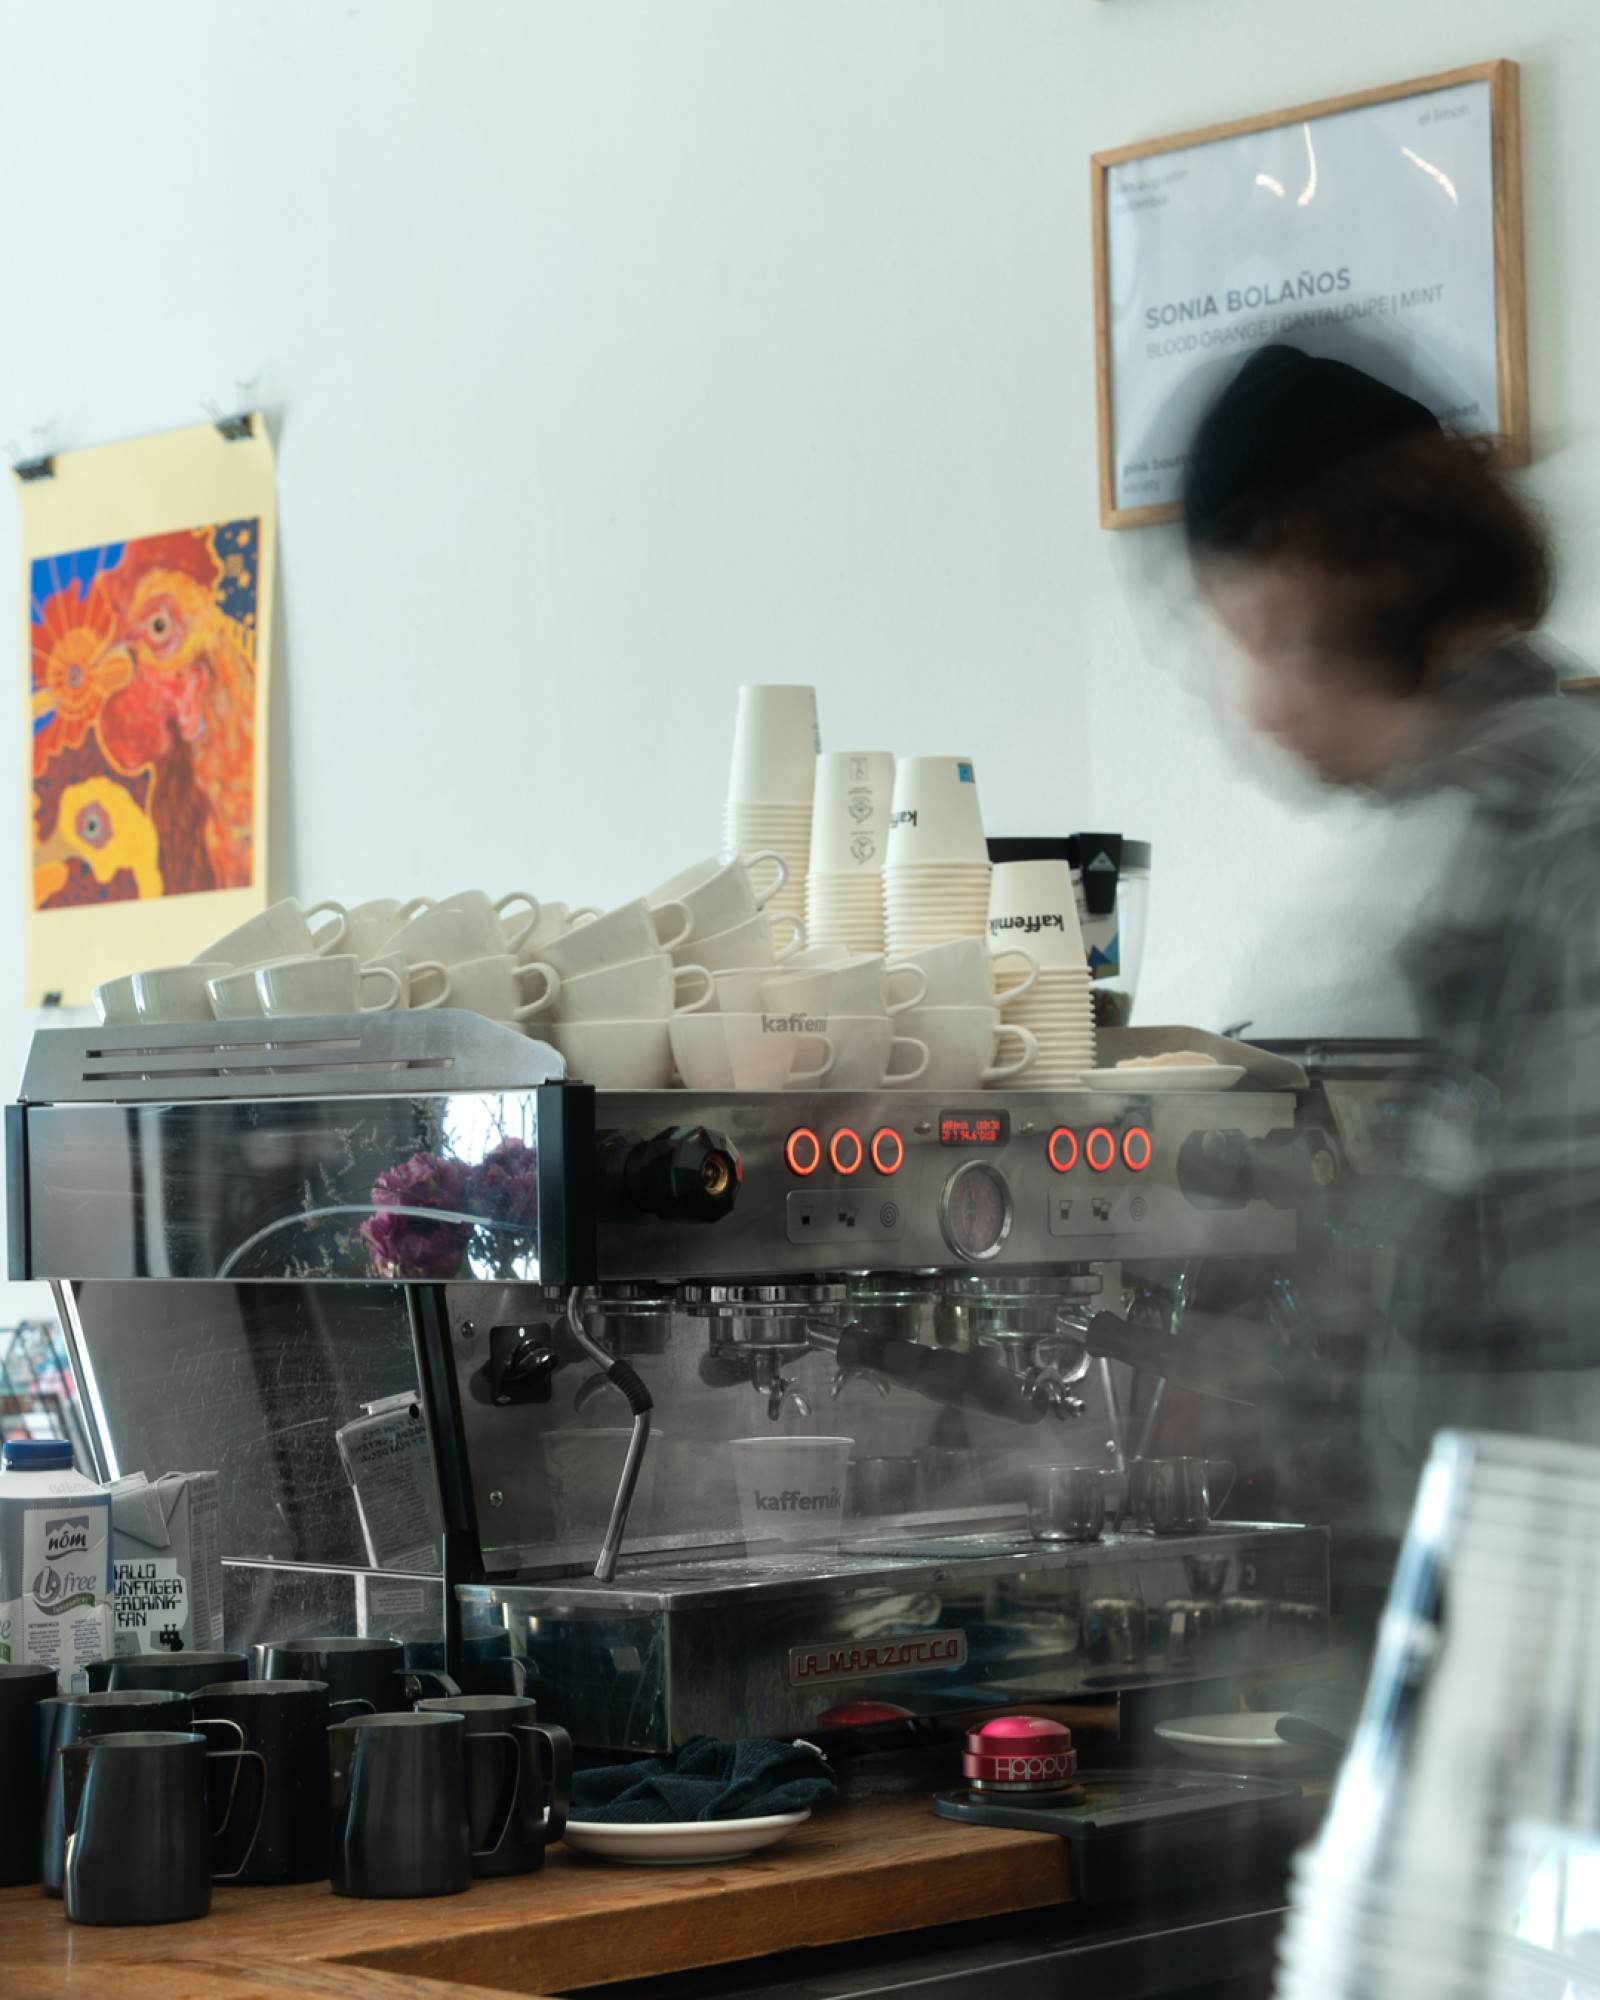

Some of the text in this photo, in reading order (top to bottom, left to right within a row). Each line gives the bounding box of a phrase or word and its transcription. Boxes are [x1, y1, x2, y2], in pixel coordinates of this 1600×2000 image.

[1145, 267, 1352, 330] SONIA BOLAÑOS
[1146, 336, 1199, 361] BLOOD
[1200, 322, 1267, 347] ORANGE
[1280, 296, 1388, 332] CANTALOUPE
[1400, 284, 1444, 309] MINT
[753, 1486, 842, 1511] kaffemik
[63, 1571, 97, 1597] free
